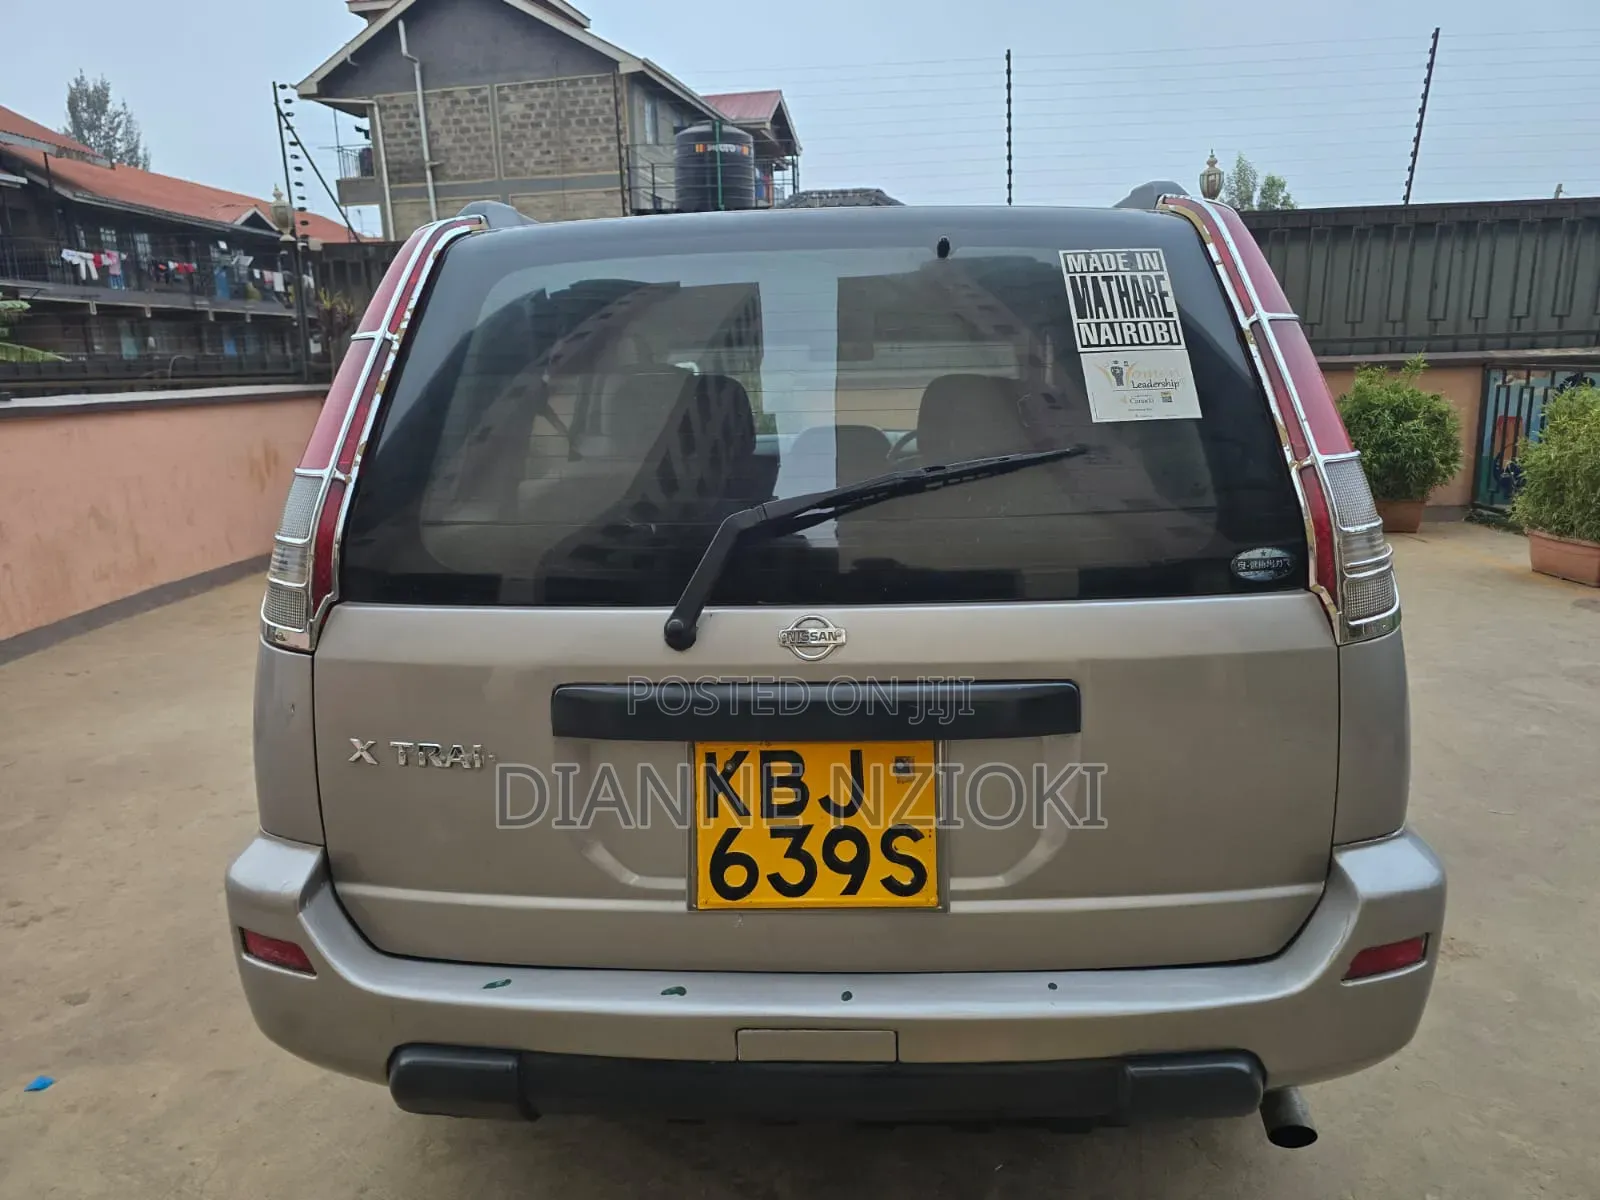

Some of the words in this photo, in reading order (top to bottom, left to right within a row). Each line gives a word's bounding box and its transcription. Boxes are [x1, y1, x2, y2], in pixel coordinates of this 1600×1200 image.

[1066, 252, 1131, 273] MADE
[1135, 251, 1161, 271] IN
[1079, 321, 1180, 346] NAIROBI
[1131, 379, 1180, 392] Leadership
[786, 630, 838, 643] NISSAN
[348, 737, 379, 765] X
[704, 748, 866, 819] KBJ
[709, 823, 928, 902] 639S
